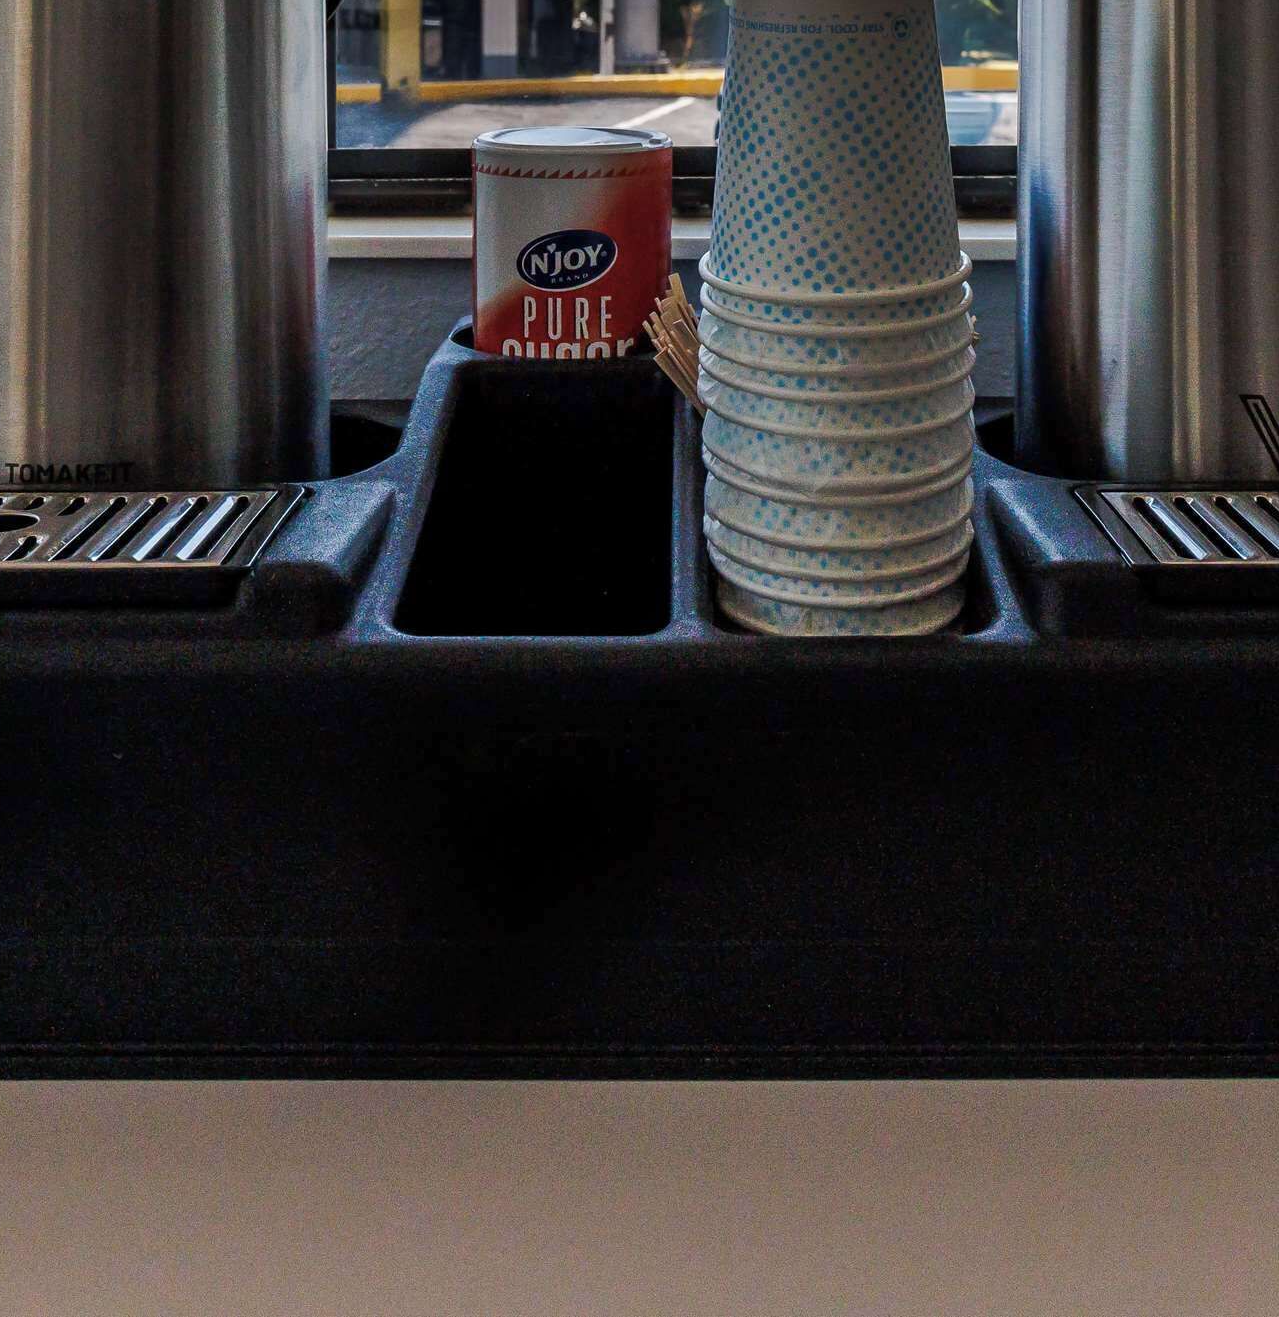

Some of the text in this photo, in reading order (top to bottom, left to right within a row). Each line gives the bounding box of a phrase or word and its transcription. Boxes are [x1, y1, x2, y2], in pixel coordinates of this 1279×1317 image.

[801, 24, 822, 35] FOR
[523, 295, 613, 340] PURE
[5, 463, 133, 484] TOMAKEIT
